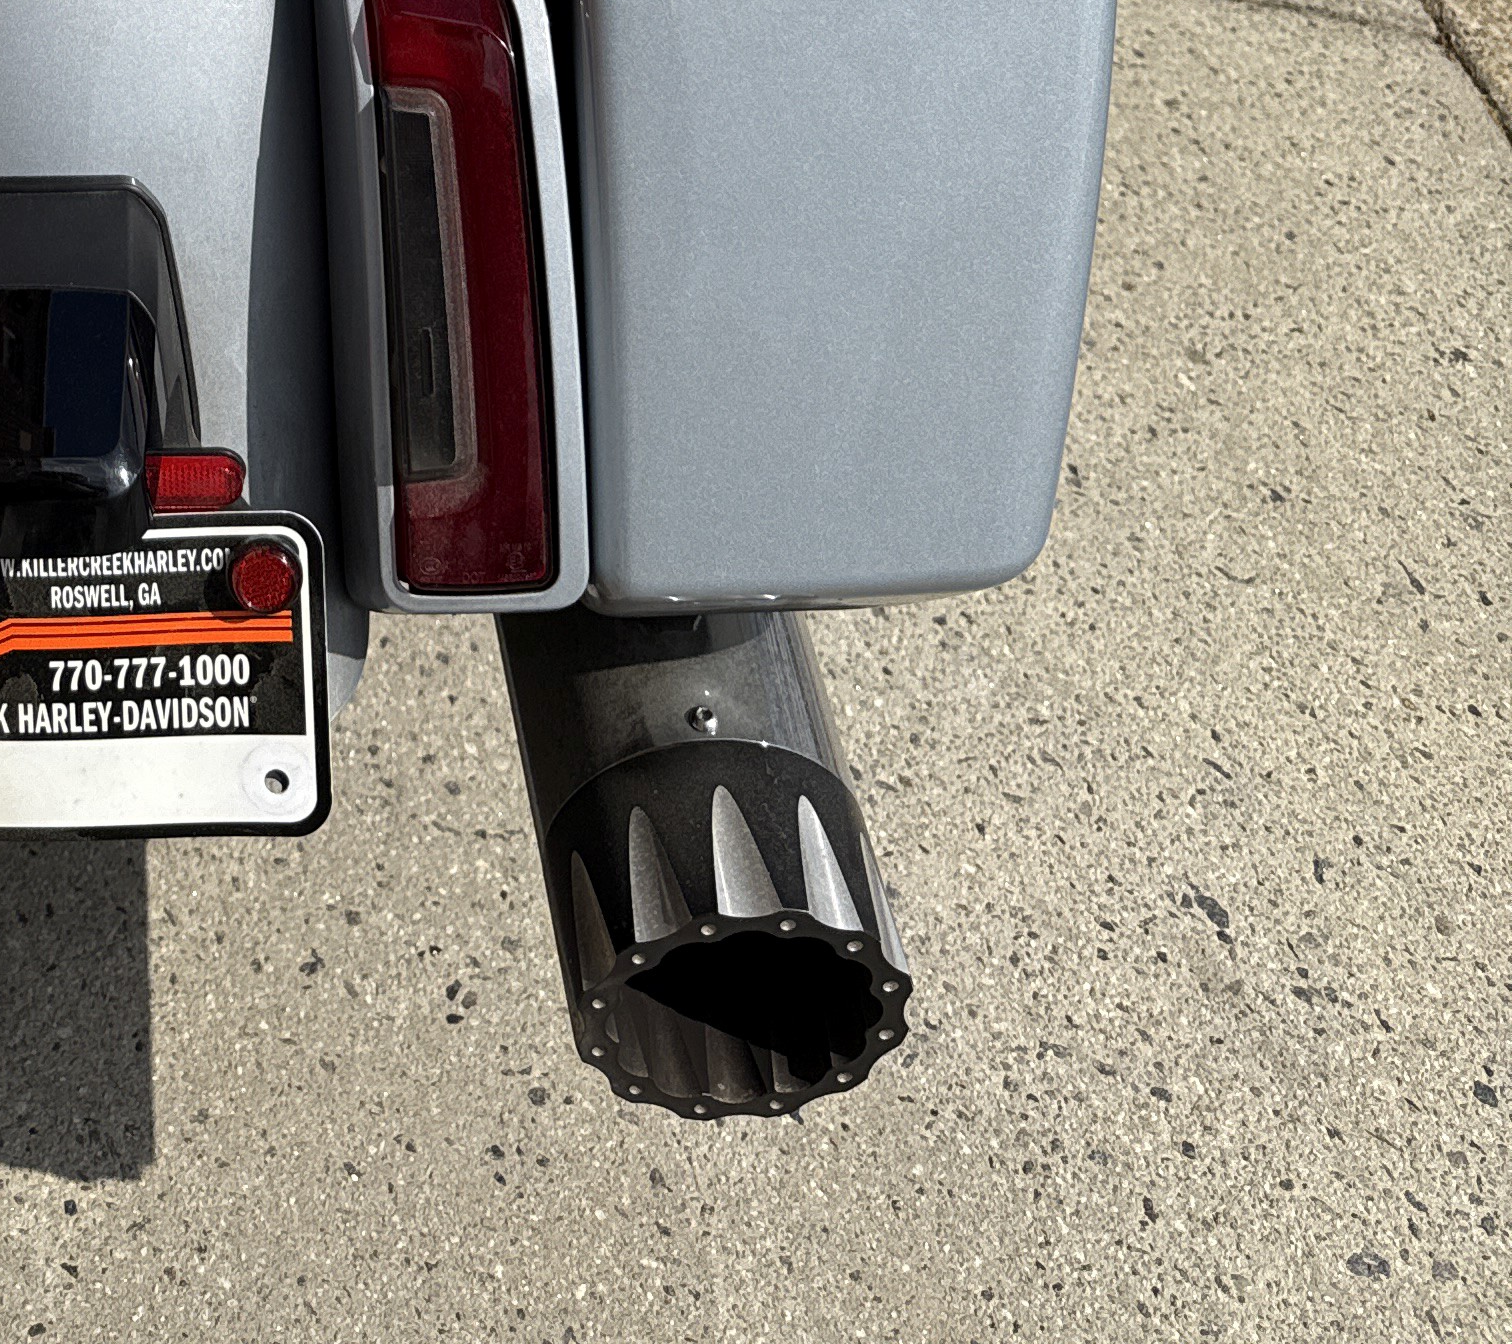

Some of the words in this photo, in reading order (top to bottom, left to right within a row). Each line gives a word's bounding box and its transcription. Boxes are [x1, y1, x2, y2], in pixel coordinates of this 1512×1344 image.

[50, 583, 135, 611] ROSWELL,
[137, 582, 162, 607] GA
[49, 654, 251, 691] 770-777-1000
